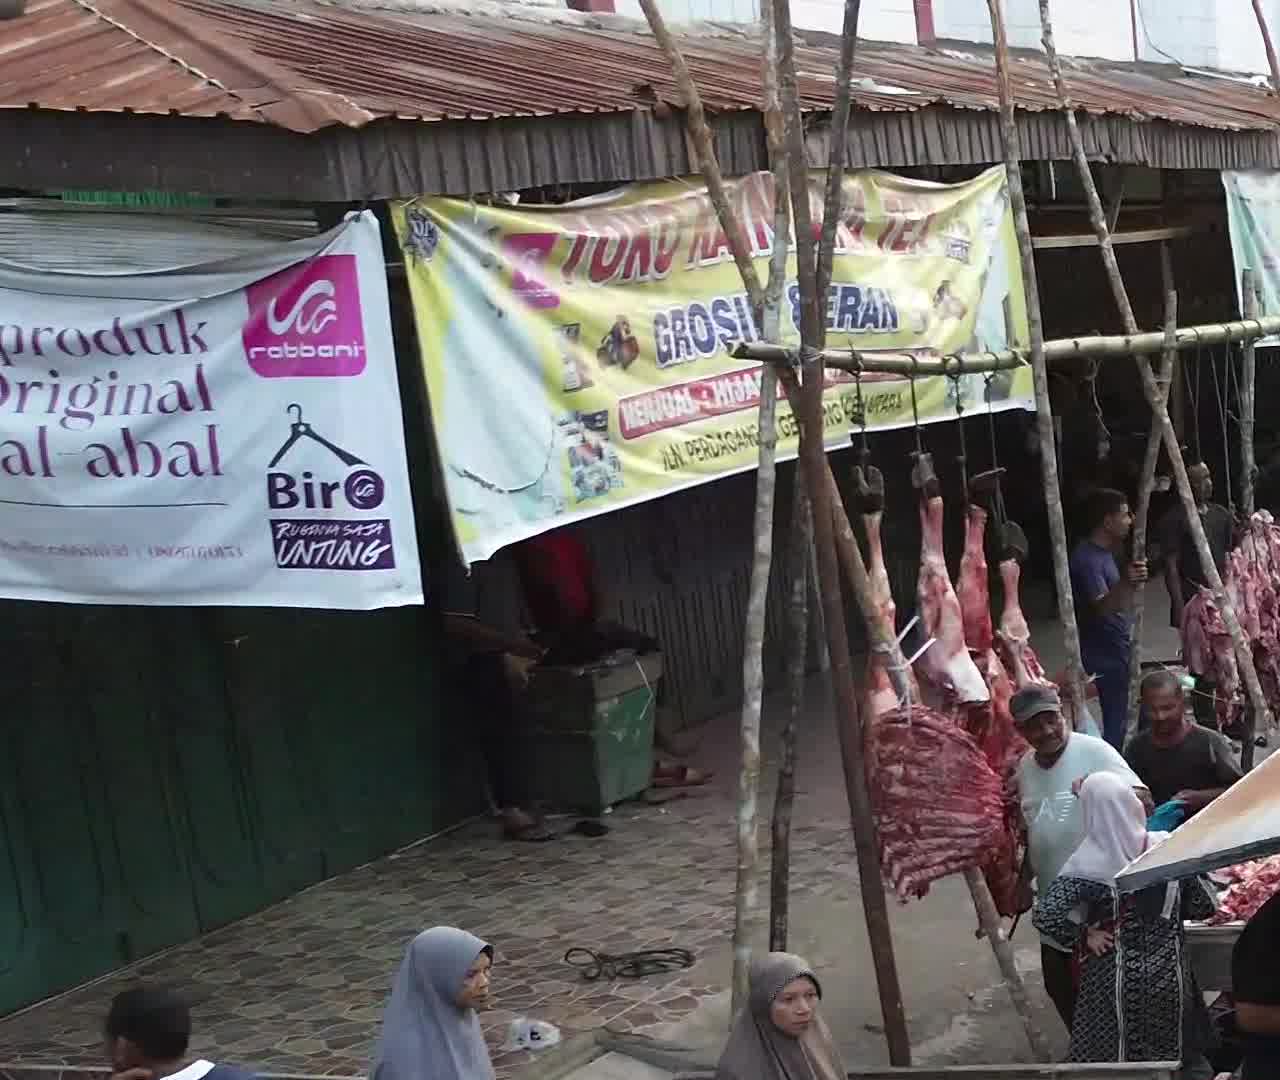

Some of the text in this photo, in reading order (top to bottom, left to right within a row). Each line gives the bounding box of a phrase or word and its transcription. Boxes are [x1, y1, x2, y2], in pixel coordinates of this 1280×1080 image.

[249, 341, 359, 359] rabbani
[0, 363, 214, 431] riginal
[277, 540, 392, 565] UNTUNG
